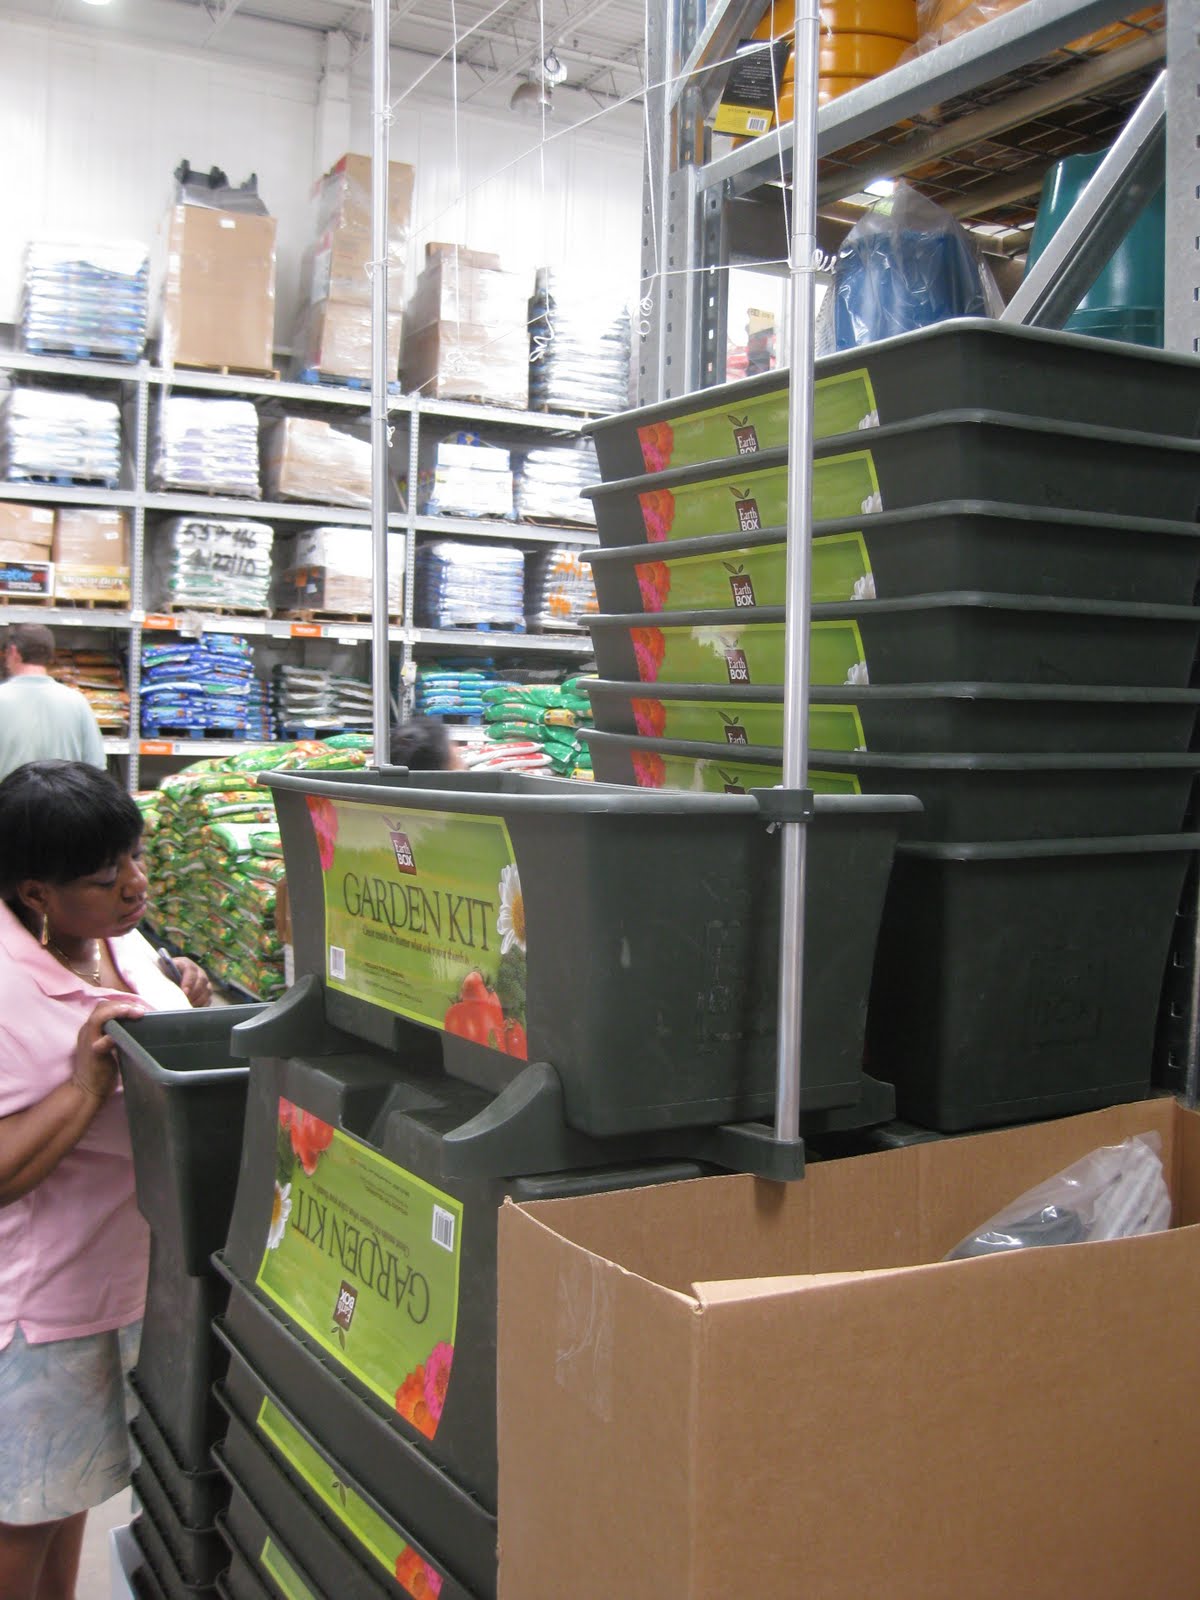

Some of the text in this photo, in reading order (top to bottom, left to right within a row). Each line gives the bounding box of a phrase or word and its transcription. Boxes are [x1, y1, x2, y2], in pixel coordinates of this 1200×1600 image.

[737, 433, 757, 448] Earth
[738, 507, 758, 520] Earth
[741, 519, 759, 531] BOX
[733, 582, 752, 596] Earth
[736, 594, 755, 607] BOX
[728, 656, 746, 668] Earth
[730, 668, 748, 680] BOX
[728, 732, 747, 744] Earth
[393, 839, 412, 855] Earth
[397, 853, 415, 867] BOX
[342, 872, 442, 939] GARDEN
[446, 892, 494, 952] KIT
[291, 1188, 328, 1250] KIT
[329, 1217, 430, 1325] GARDEN
[340, 1288, 356, 1309] BOX
